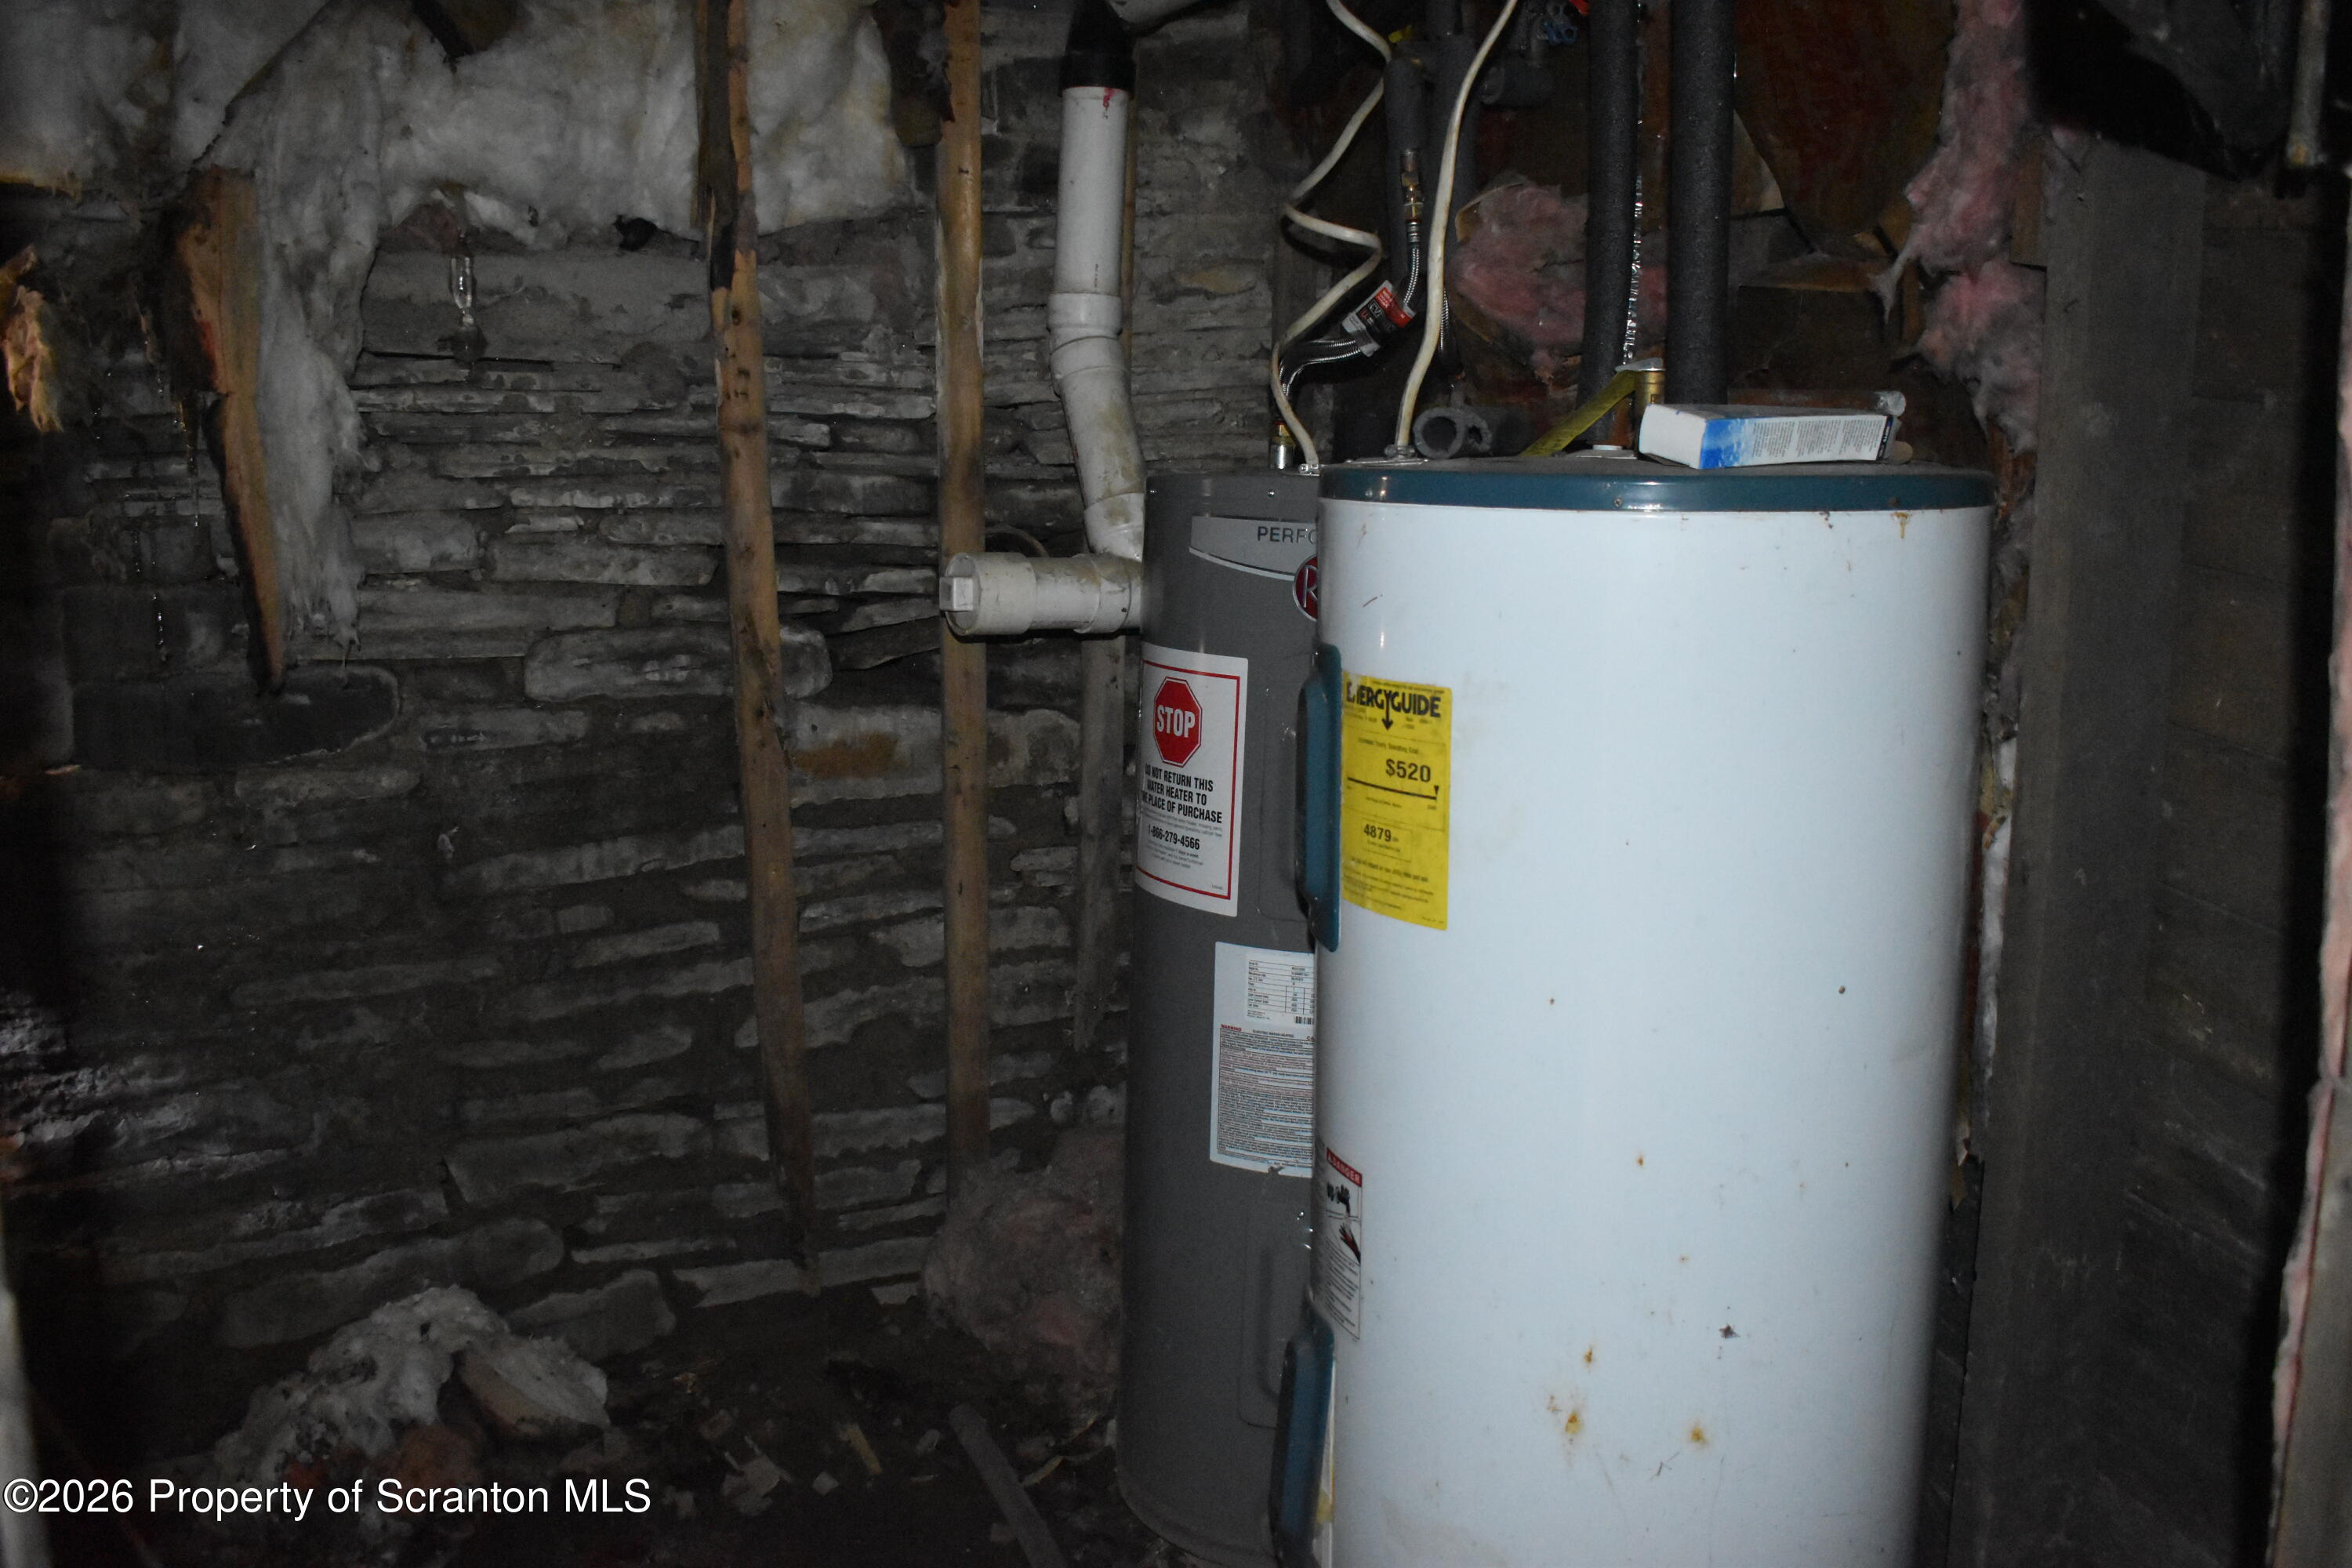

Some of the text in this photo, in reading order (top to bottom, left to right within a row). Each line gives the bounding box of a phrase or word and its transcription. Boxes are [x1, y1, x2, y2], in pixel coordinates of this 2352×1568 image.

[1156, 705, 1196, 738] STOP
[1145, 763, 1214, 792] DO NOT RETURN THIS
[1385, 758, 1431, 782] $520
[1147, 779, 1207, 805] WATER HEATER TO
[1148, 793, 1166, 810] PLACE
[1167, 800, 1176, 813] OF
[1178, 804, 1222, 823] PURCHASE
[1148, 824, 1200, 850] 1-866-279-4566
[1363, 823, 1392, 843] 4879
